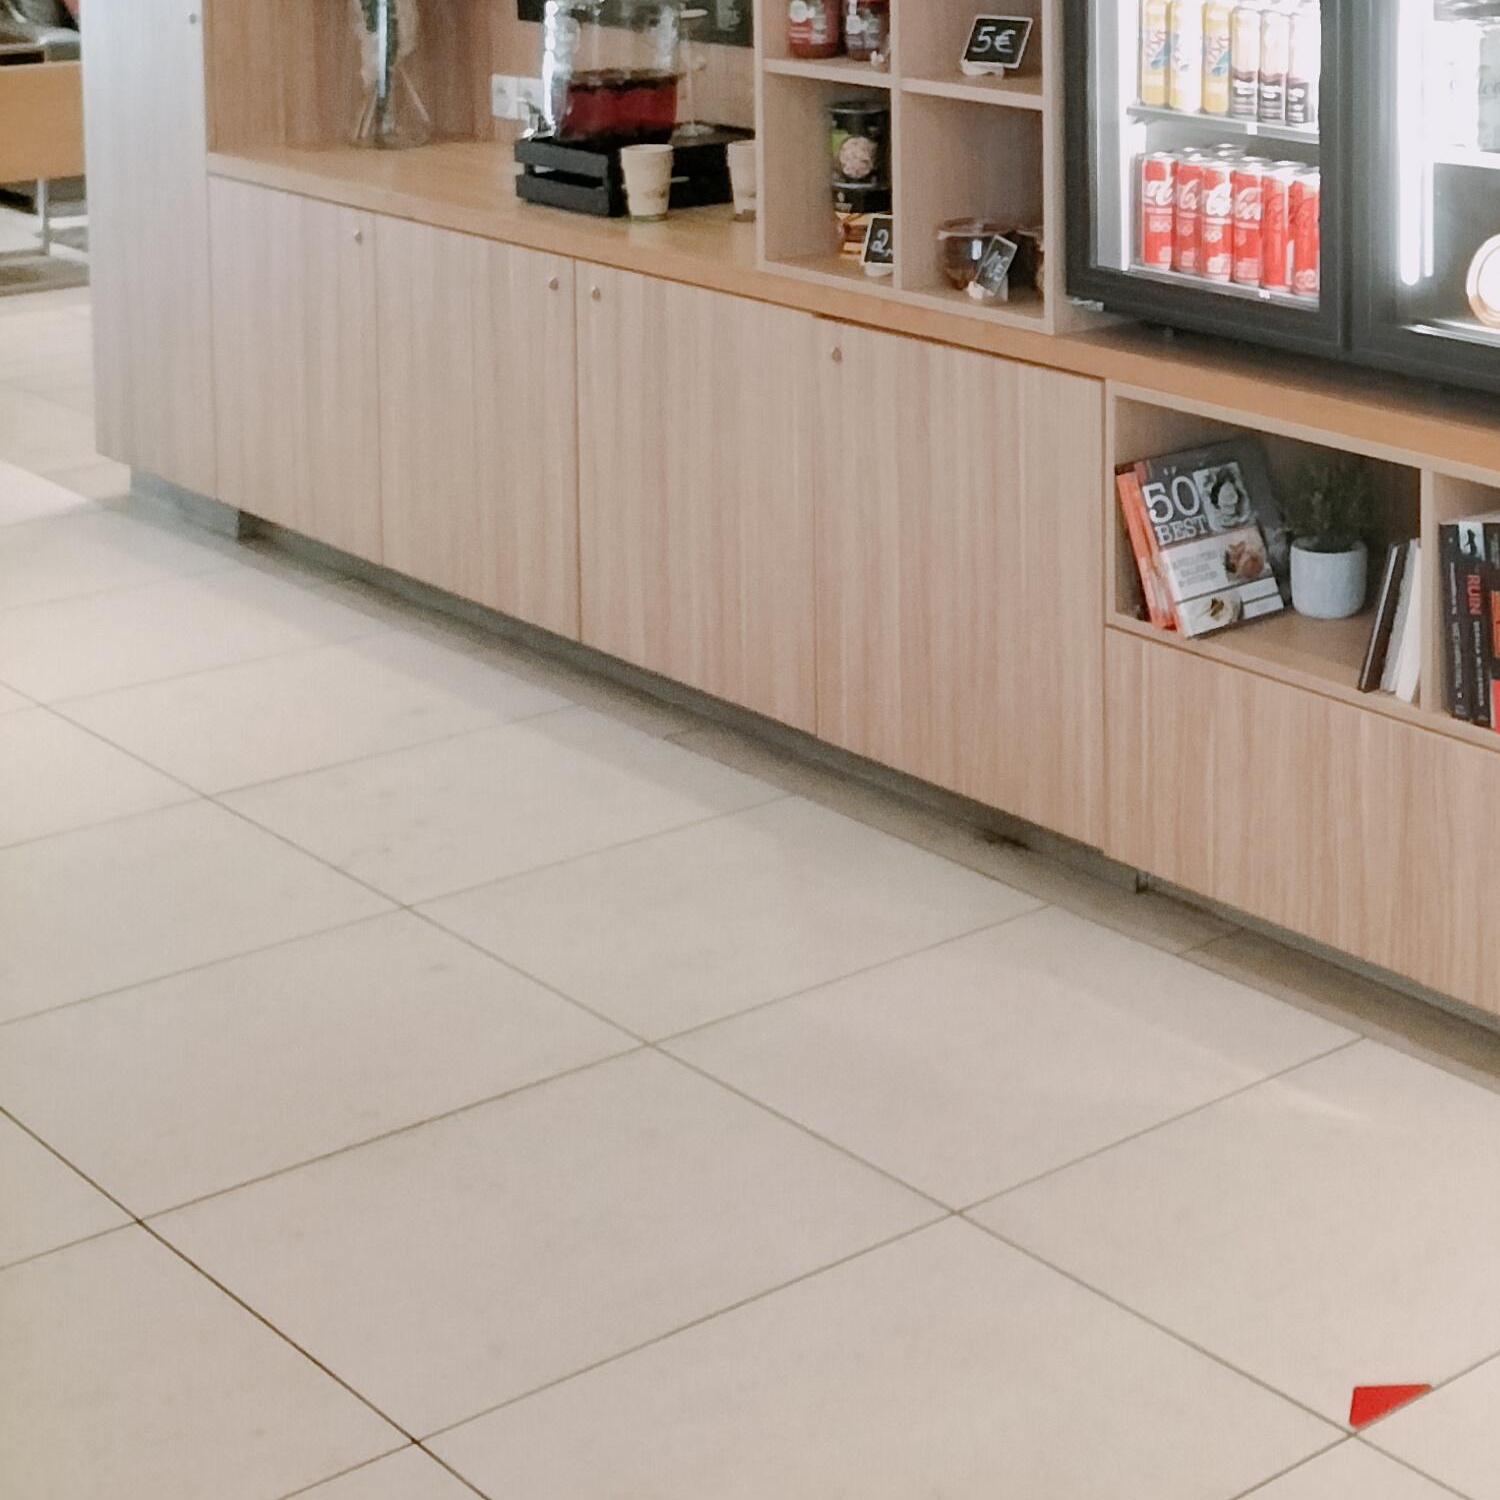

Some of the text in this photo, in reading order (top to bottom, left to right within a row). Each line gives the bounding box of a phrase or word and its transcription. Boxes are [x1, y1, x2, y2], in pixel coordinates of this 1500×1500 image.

[971, 25, 1017, 55] 5€
[1142, 475, 1202, 523] 50
[1154, 514, 1210, 546] BEST
[1466, 574, 1482, 615] RUIN
